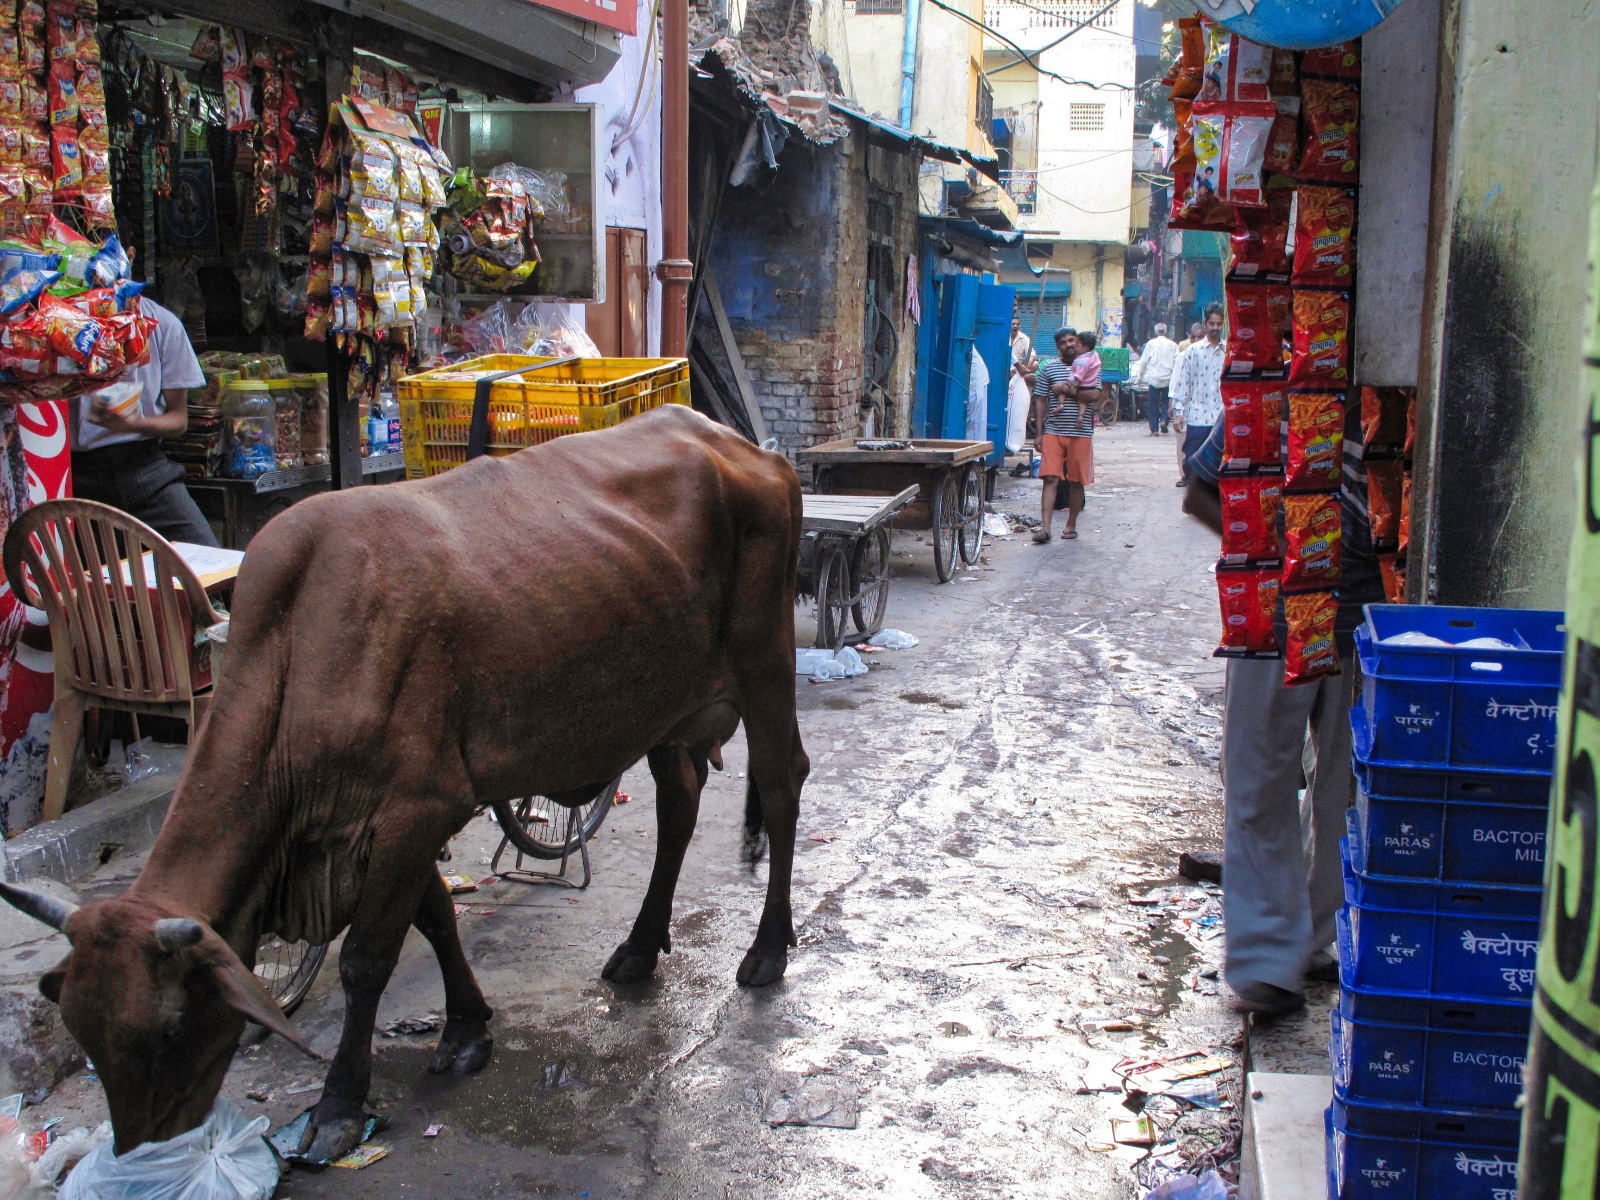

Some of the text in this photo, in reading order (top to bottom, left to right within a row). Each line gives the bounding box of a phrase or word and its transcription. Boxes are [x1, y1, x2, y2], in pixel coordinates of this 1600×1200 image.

[1302, 639, 1331, 657] Chulbule
[1384, 836, 1431, 849] PARAS
[1473, 828, 1546, 845] BACTOF
[1515, 848, 1543, 862] MIL
[1376, 946, 1416, 957] पारस
[1500, 967, 1536, 993] दूध
[1369, 1062, 1410, 1074] PARAS
[1494, 1071, 1523, 1085] MIL
[1361, 1169, 1401, 1180] पारस
